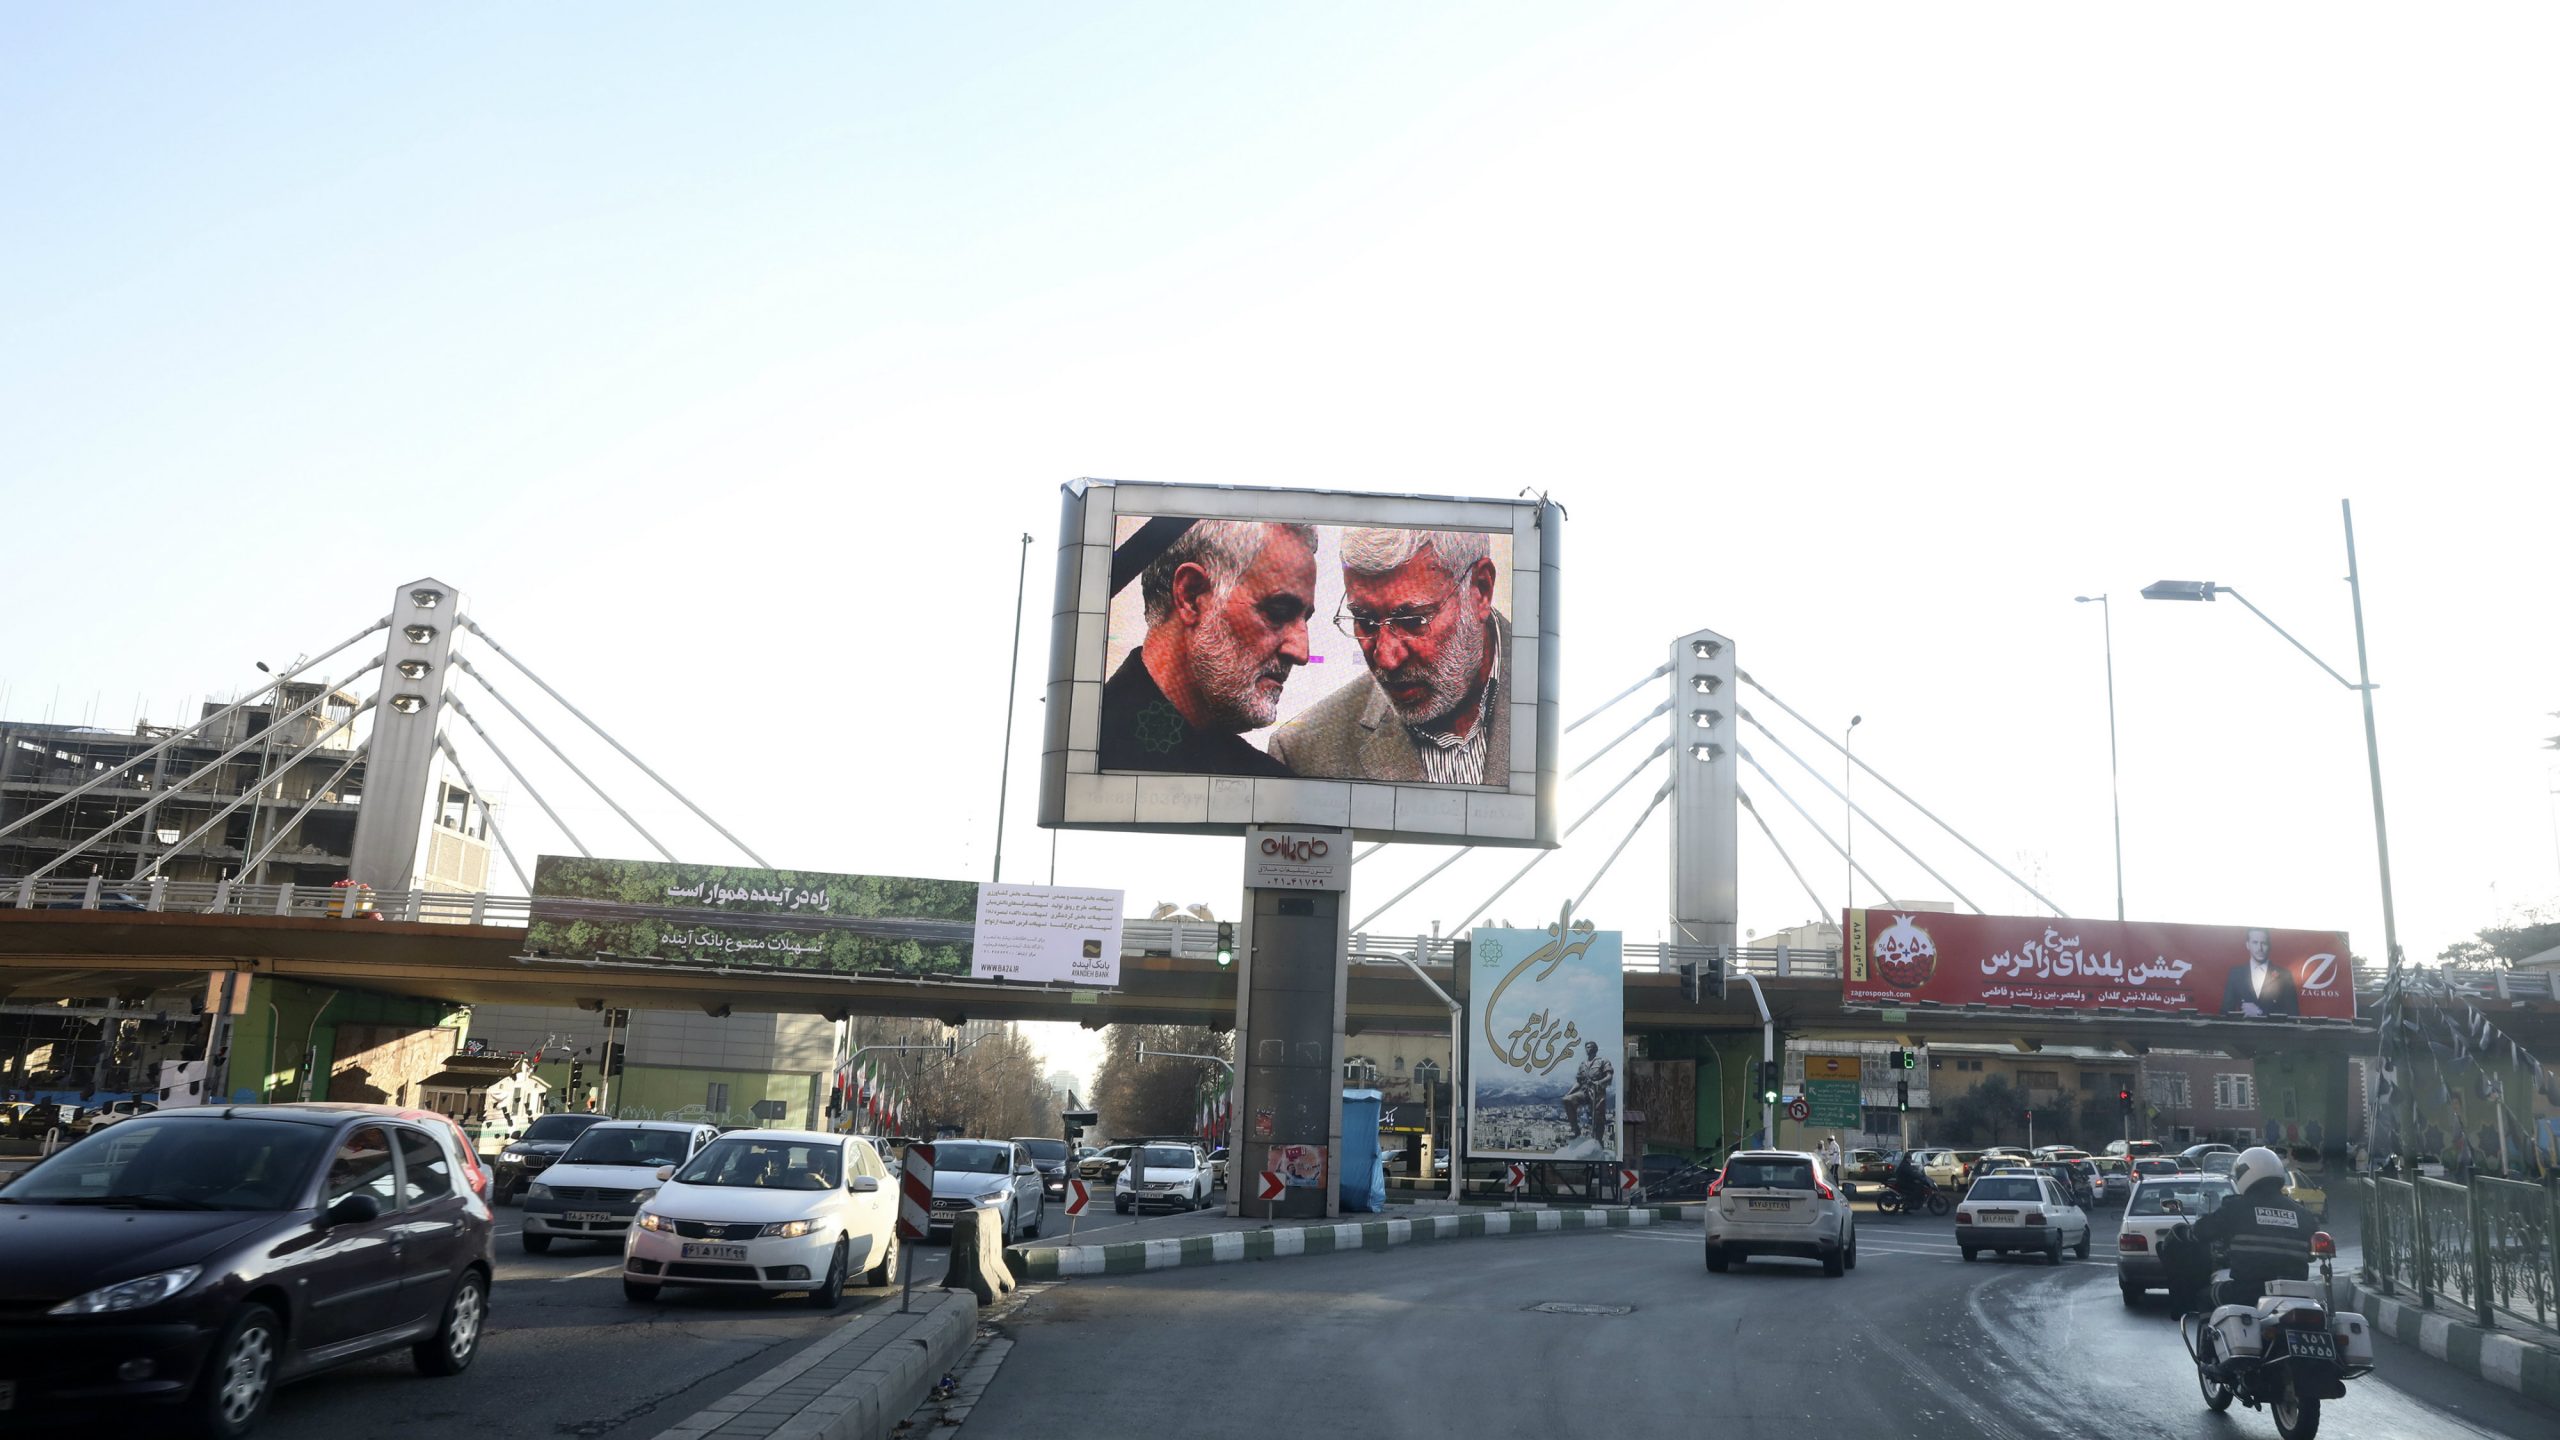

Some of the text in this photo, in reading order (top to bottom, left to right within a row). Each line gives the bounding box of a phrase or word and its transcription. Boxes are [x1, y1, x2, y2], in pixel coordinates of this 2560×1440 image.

[667, 882, 830, 911] راه در آینده هموار است
[661, 930, 824, 955] تسهیلات متنوع بانک آینده
[2044, 925, 2080, 952] سرخ
[1072, 959, 1110, 970] بانک آینده
[1981, 939, 2193, 986] جشن یلدای زاگرس
[1485, 899, 1598, 1064] تهران
[1850, 990, 1911, 998] zagrospoosh.com
[2301, 989, 2340, 997] ZAGROS
[2258, 1209, 2294, 1219] POLICE
[2301, 1333, 2326, 1344] ۹۵۱
[2291, 1344, 2333, 1356] ۴۵۴۵۵
